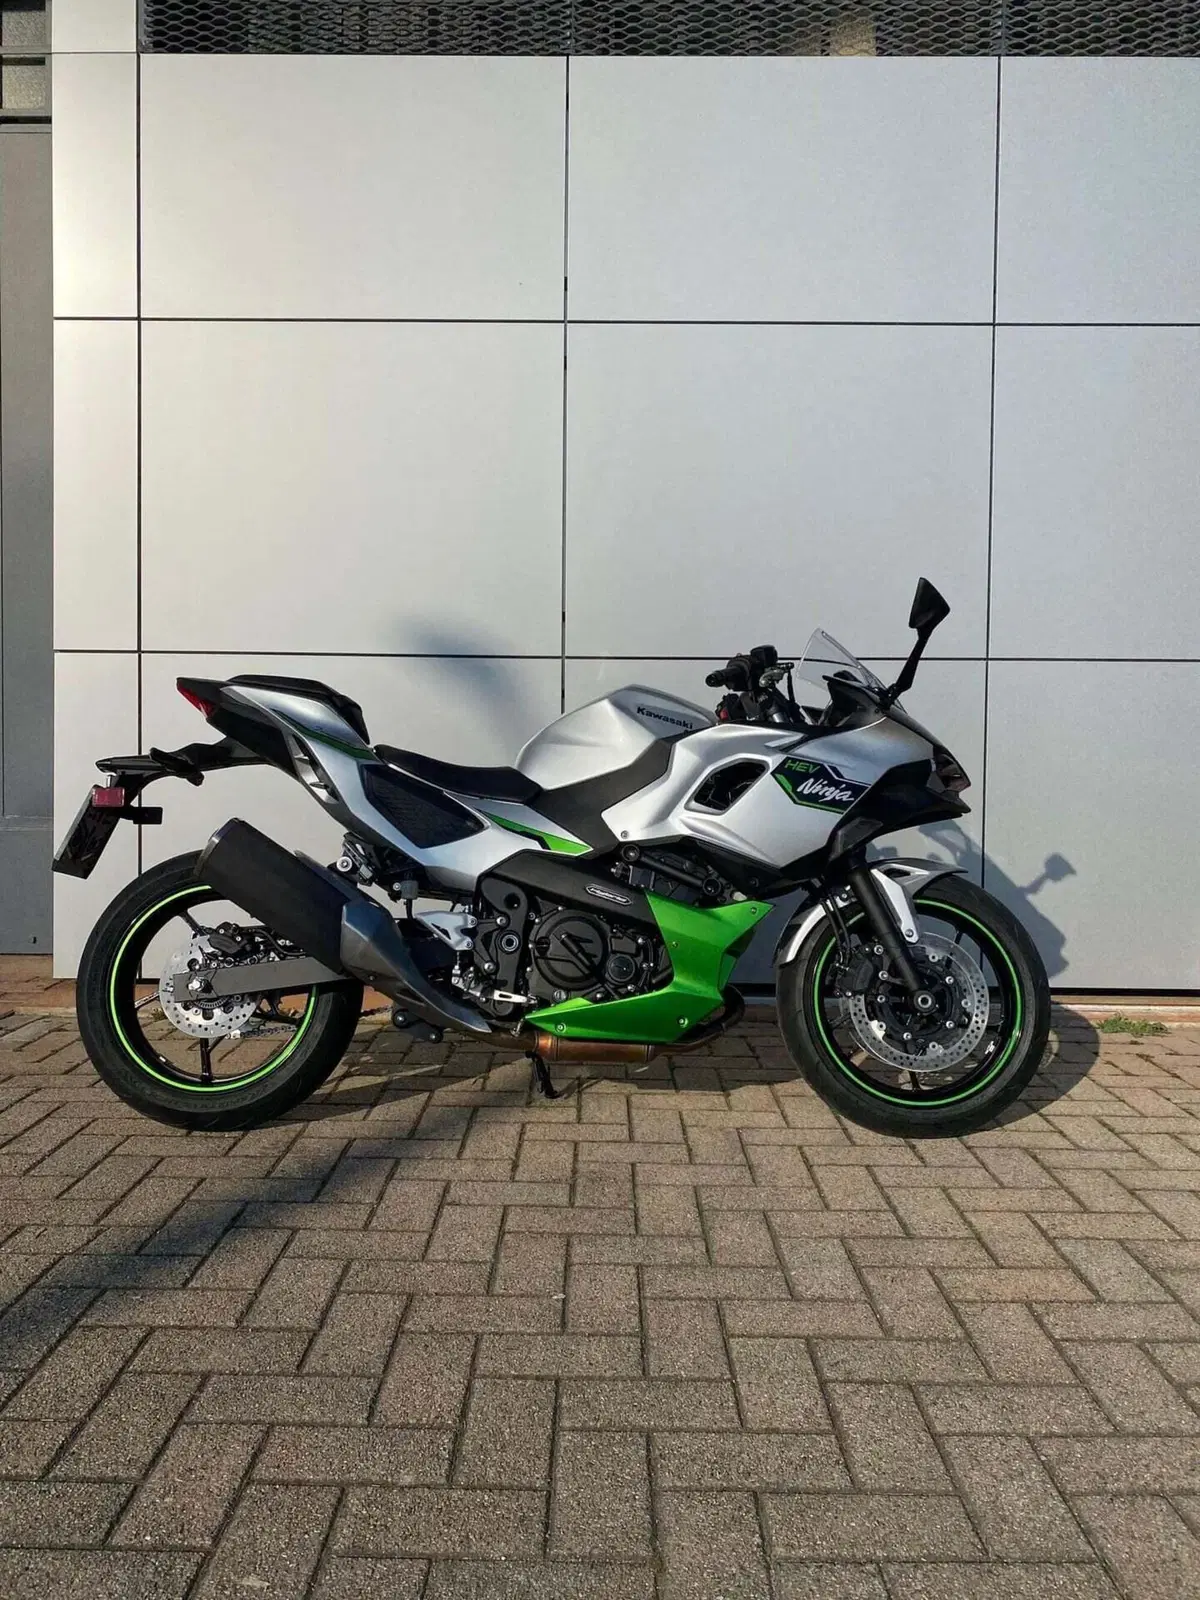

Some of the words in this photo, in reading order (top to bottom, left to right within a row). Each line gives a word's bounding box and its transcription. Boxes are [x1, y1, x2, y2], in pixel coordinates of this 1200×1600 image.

[637, 706, 693, 729] Kawasaki
[784, 760, 821, 774] HEV
[796, 778, 855, 802] Ninja
